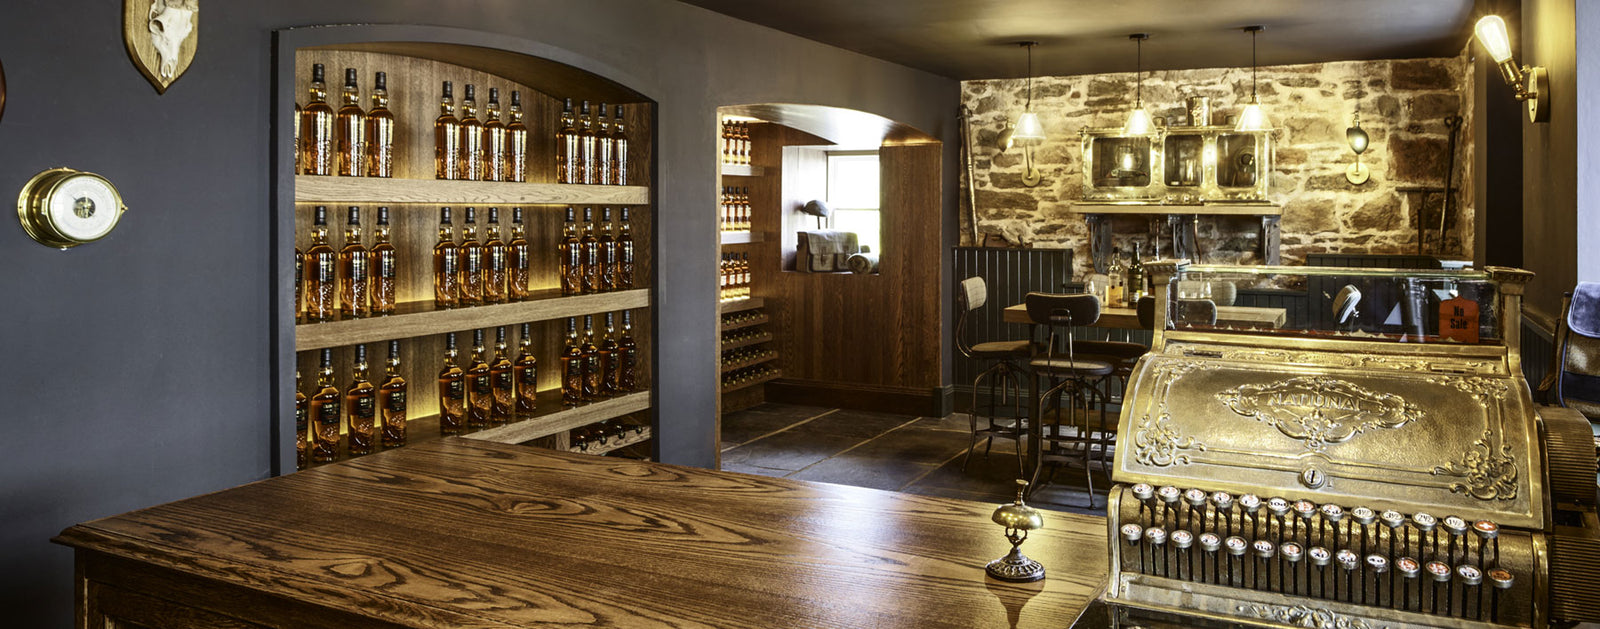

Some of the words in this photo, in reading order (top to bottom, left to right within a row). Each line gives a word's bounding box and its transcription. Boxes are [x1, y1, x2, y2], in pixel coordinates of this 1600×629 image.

[1454, 306, 1465, 317] No
[1450, 318, 1468, 329] Sale
[1267, 392, 1362, 412] NATIONAL
